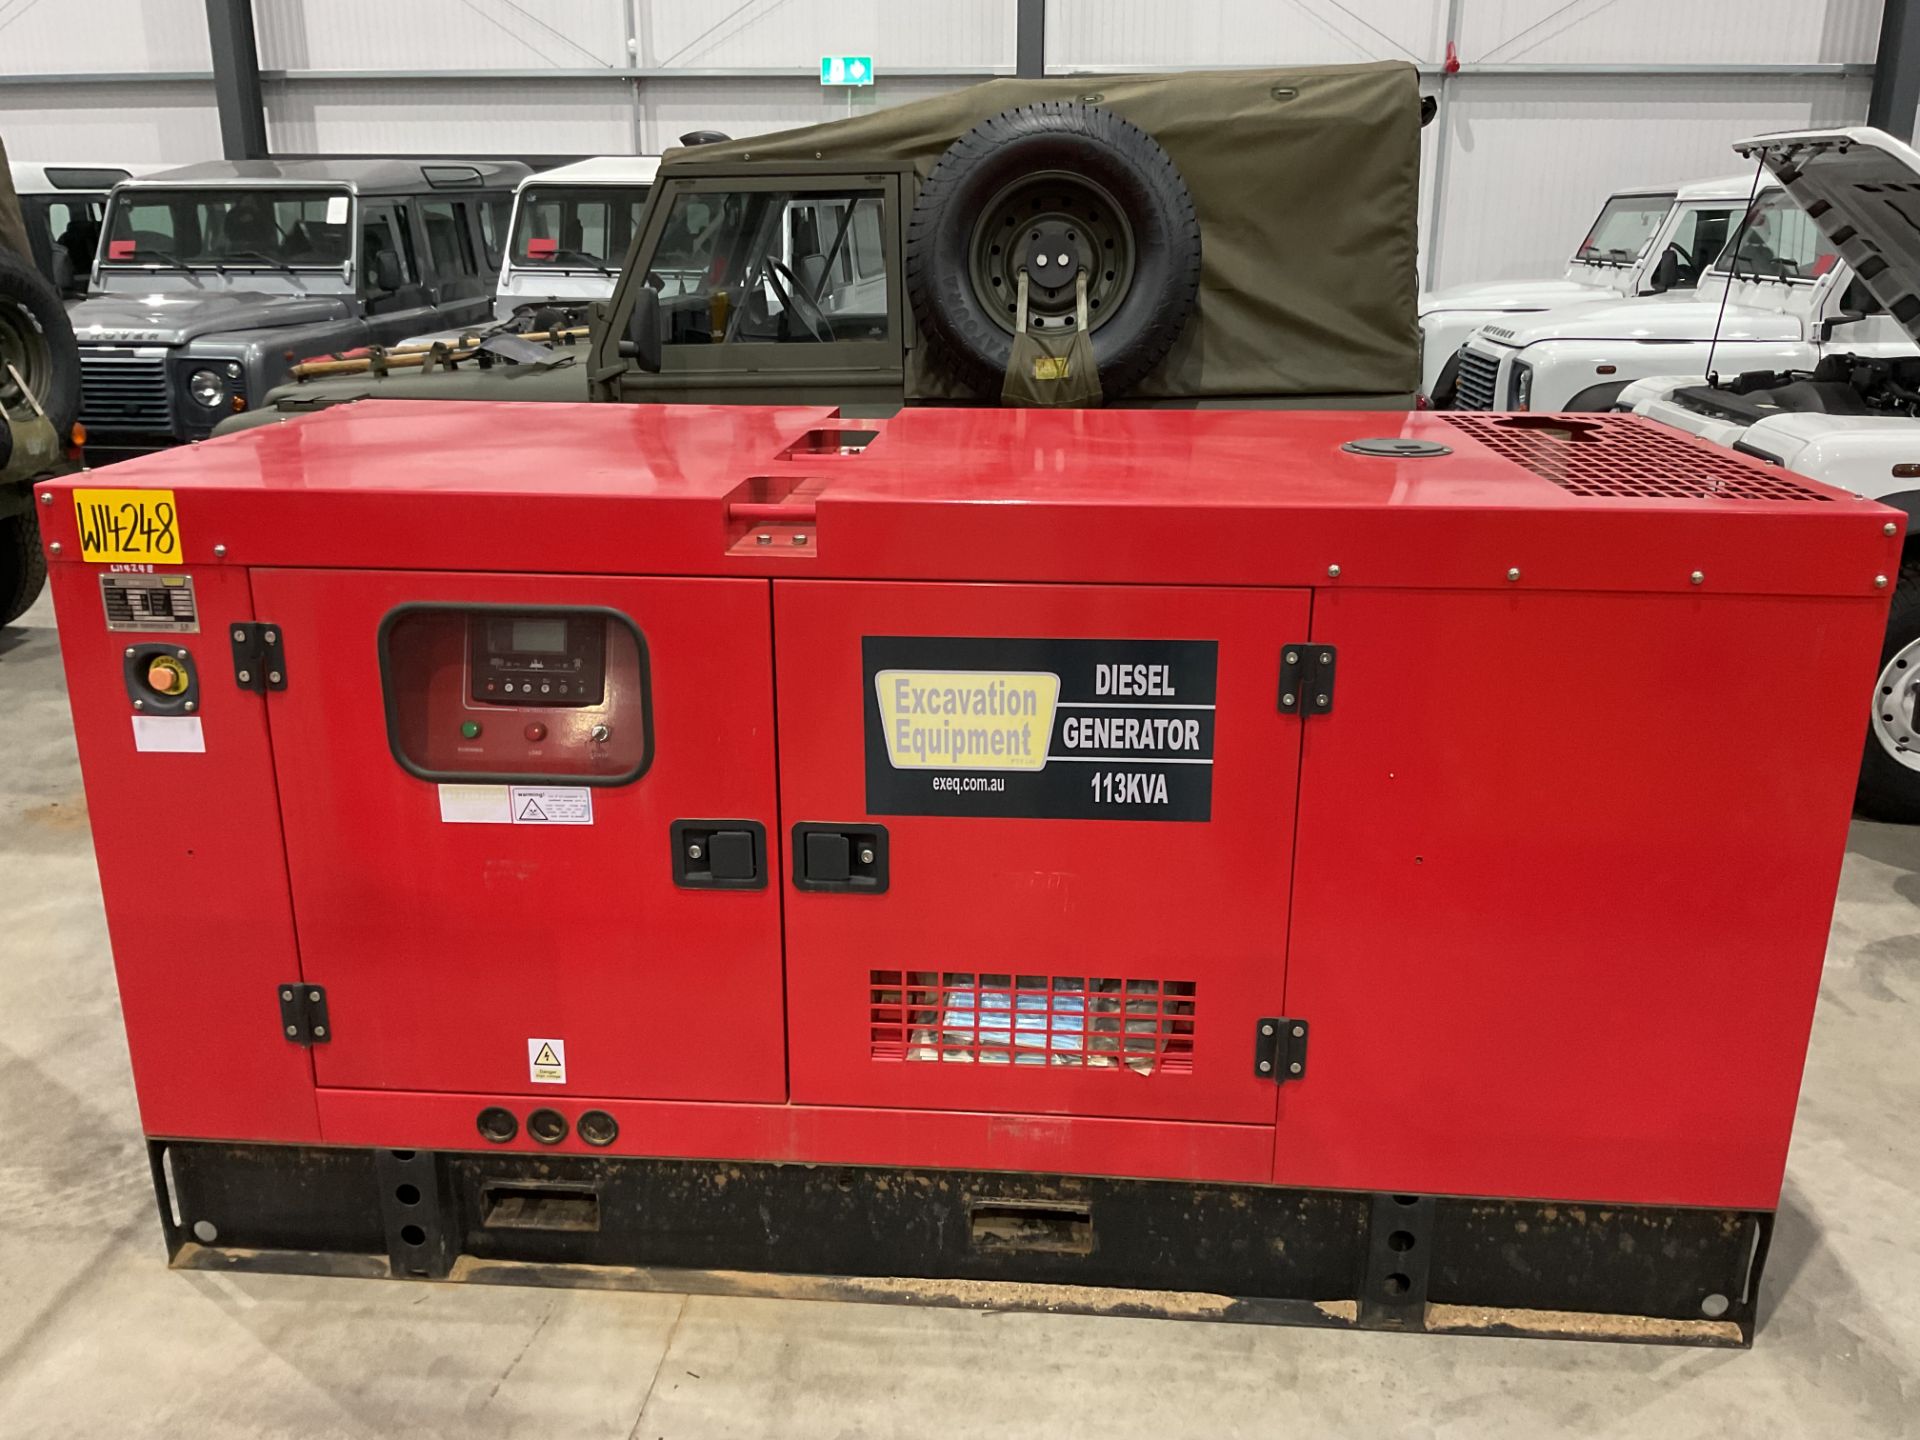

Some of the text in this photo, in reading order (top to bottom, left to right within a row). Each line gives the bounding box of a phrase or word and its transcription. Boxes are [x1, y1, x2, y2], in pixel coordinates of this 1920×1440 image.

[76, 502, 175, 554] W14248
[894, 678, 1038, 716] Excavation
[1095, 663, 1176, 697] DIESEL
[895, 718, 1032, 764] Equipment
[1062, 716, 1201, 751] GENERATOR
[932, 776, 1006, 796] exeq.com.au
[1090, 771, 1169, 804] 113KVA
